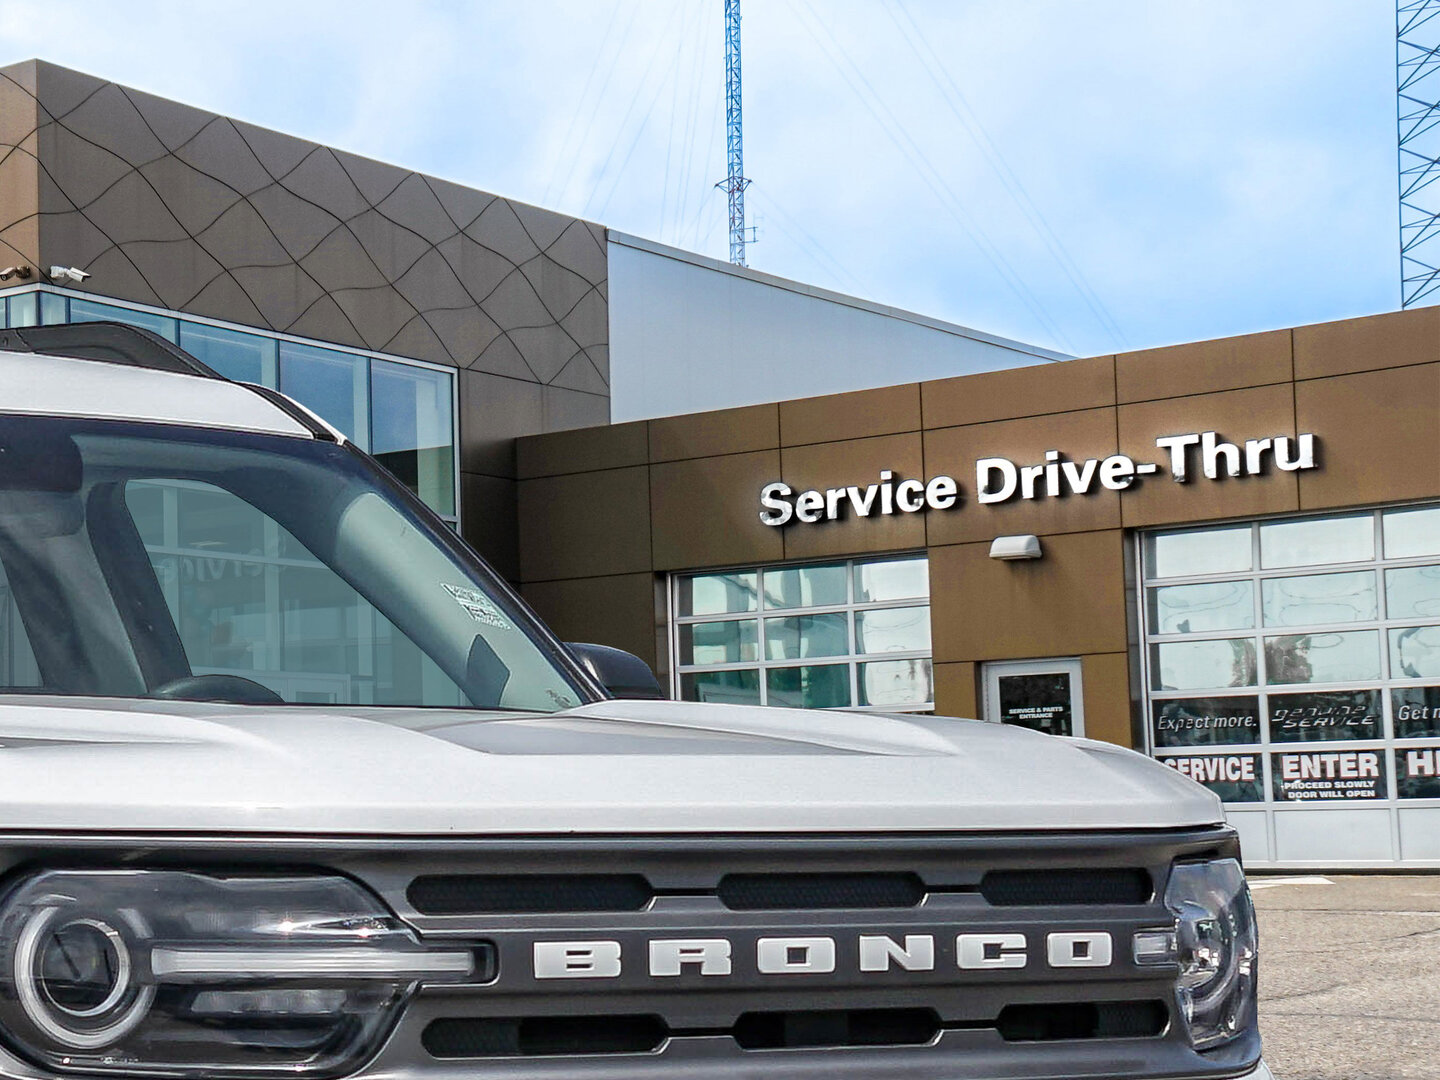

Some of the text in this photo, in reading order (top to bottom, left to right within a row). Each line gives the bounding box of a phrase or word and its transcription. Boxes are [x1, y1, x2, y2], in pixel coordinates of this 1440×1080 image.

[759, 431, 1315, 526] Service Drive-Thru
[1009, 706, 1035, 714] SERVICE
[1398, 705, 1429, 721] Get
[1158, 714, 1257, 732] Expect more.
[1282, 715, 1377, 728] SERVICE
[1282, 752, 1379, 779] ENTER
[1284, 780, 1375, 790] PROCEED SLOWLY
[1288, 789, 1376, 799] DOOR WILL OPEN
[533, 931, 1113, 979] BRONCO
